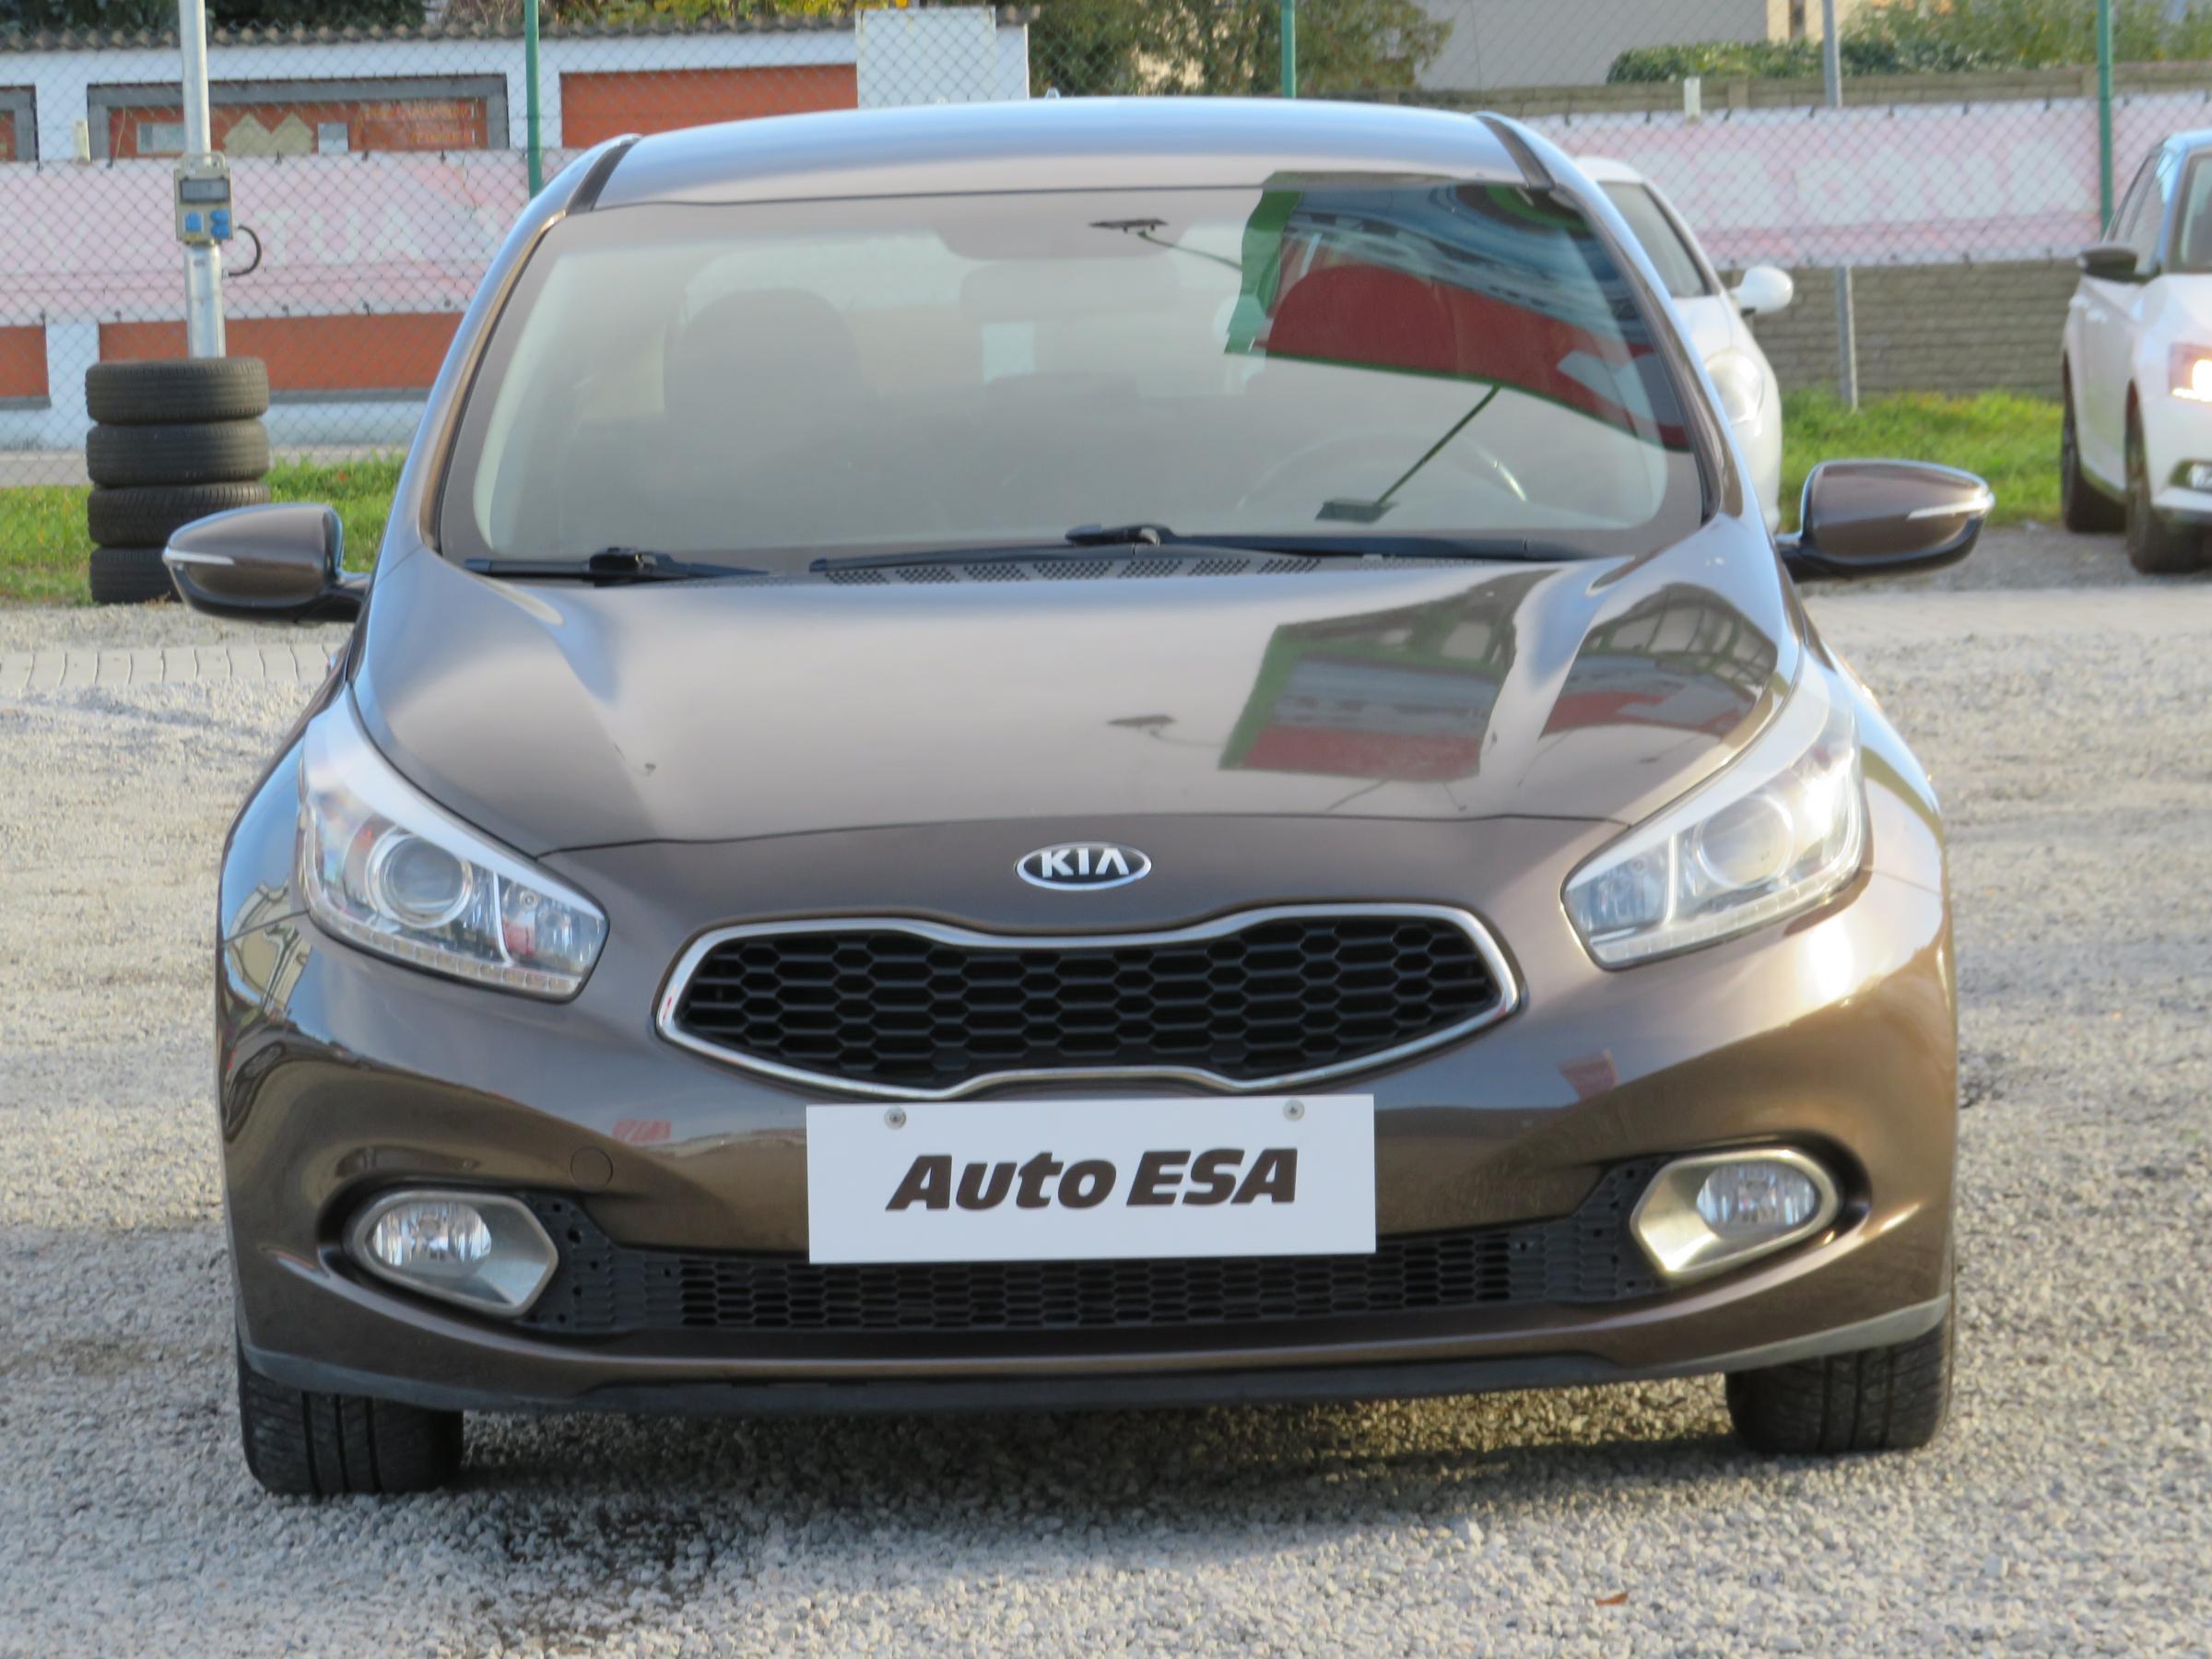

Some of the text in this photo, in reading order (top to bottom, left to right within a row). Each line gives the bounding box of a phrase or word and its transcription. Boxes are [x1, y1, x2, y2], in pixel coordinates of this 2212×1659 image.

[1040, 847, 1129, 877] KIA
[885, 1147, 1298, 1211] Auto ESA
